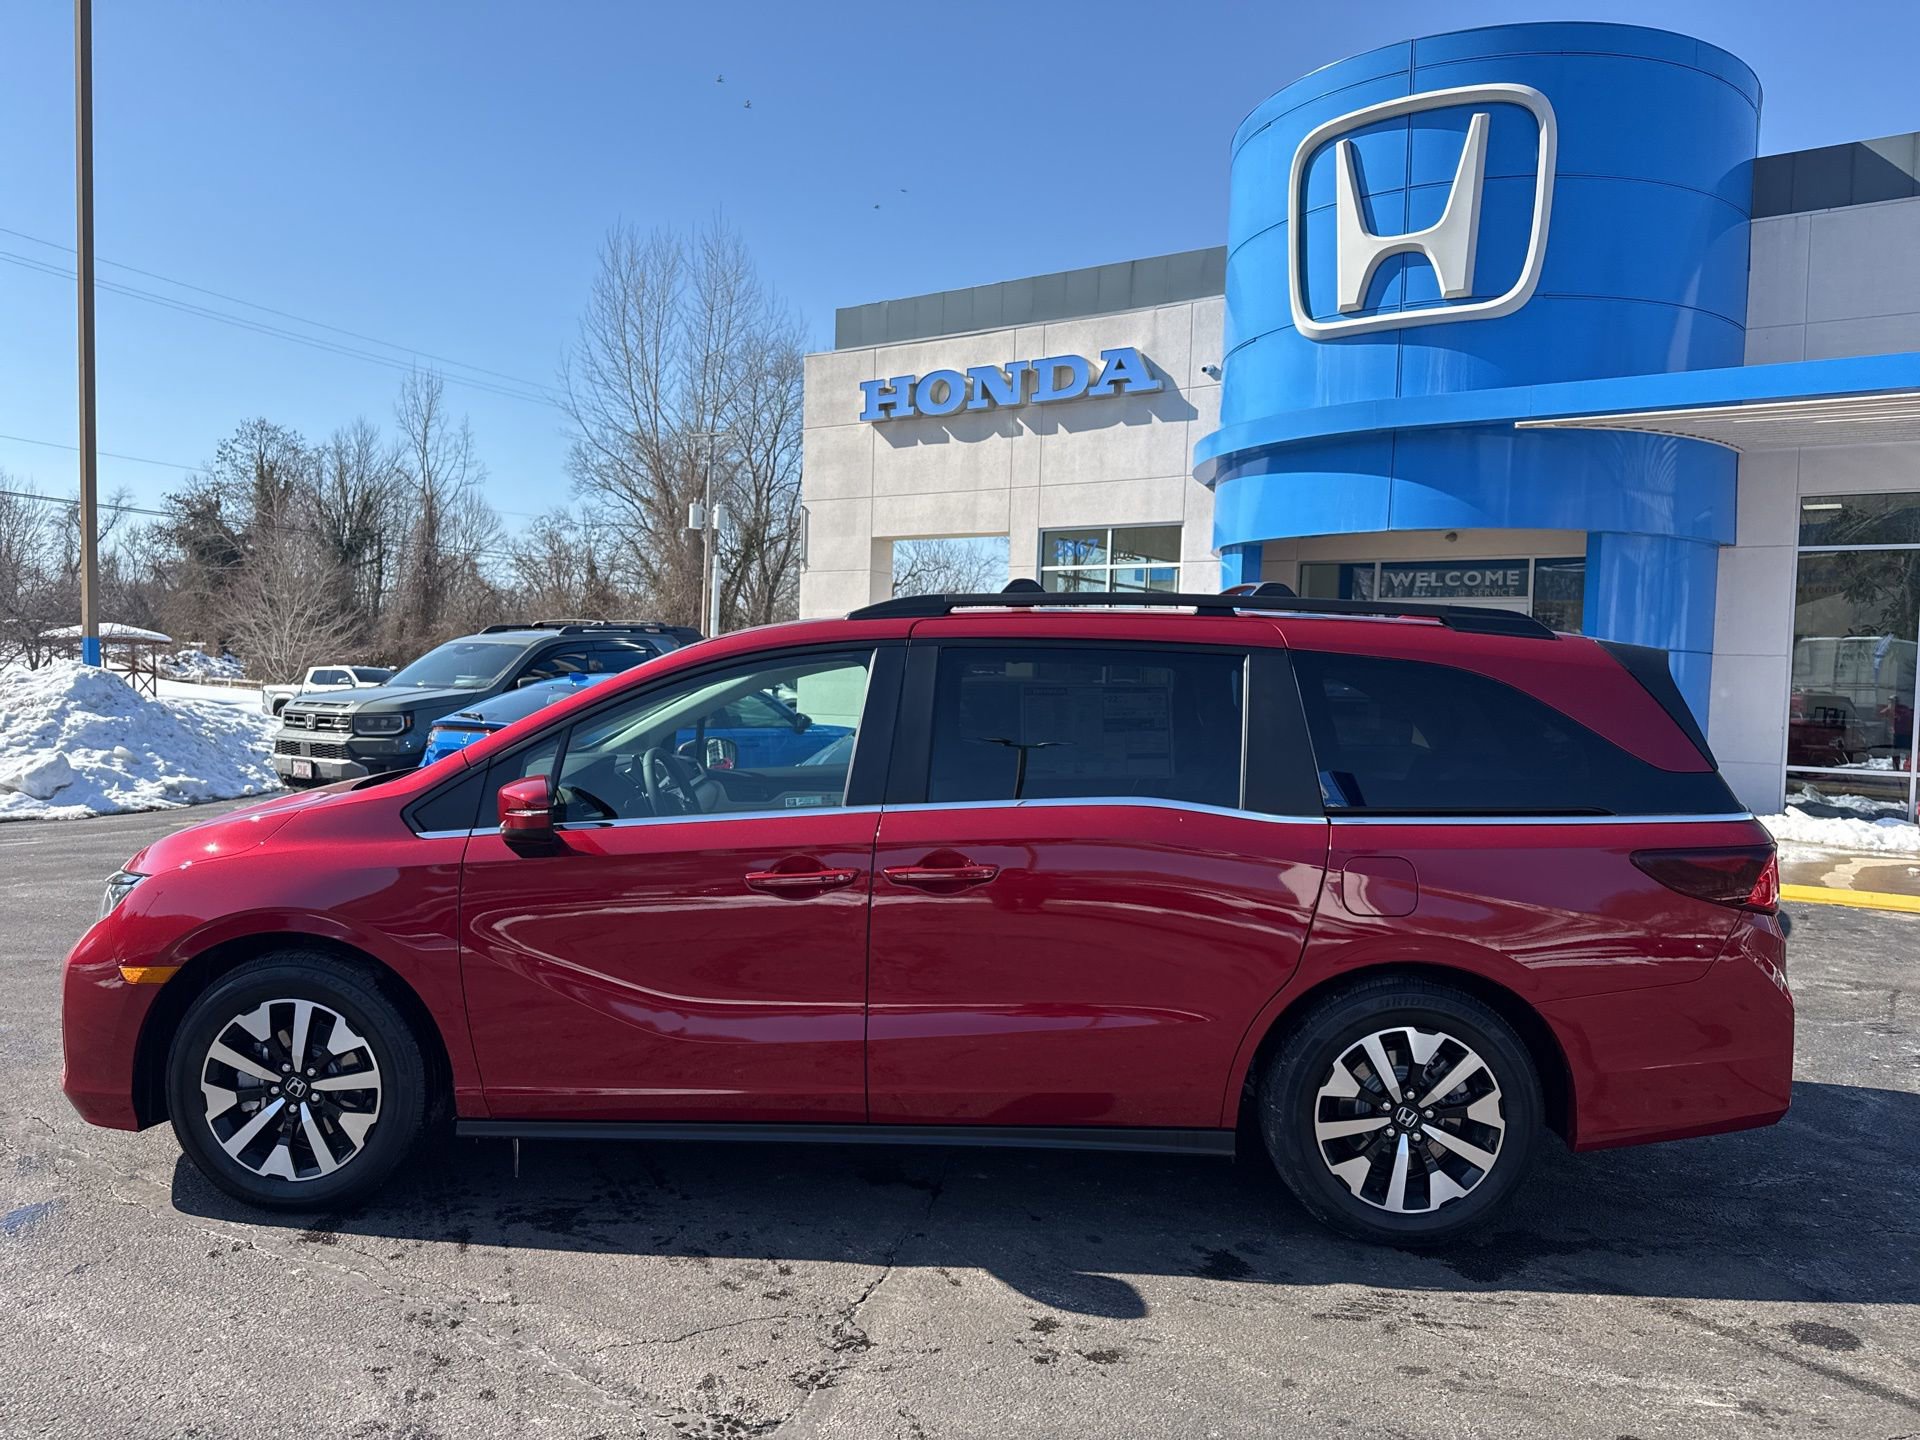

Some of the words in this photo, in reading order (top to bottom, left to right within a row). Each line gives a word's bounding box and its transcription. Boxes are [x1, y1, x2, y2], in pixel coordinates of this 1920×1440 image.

[859, 346, 1163, 422] HONDA
[1054, 539, 1098, 557] 2867
[1389, 570, 1519, 587] WELCOME
[1472, 587, 1515, 597] SERVICE
